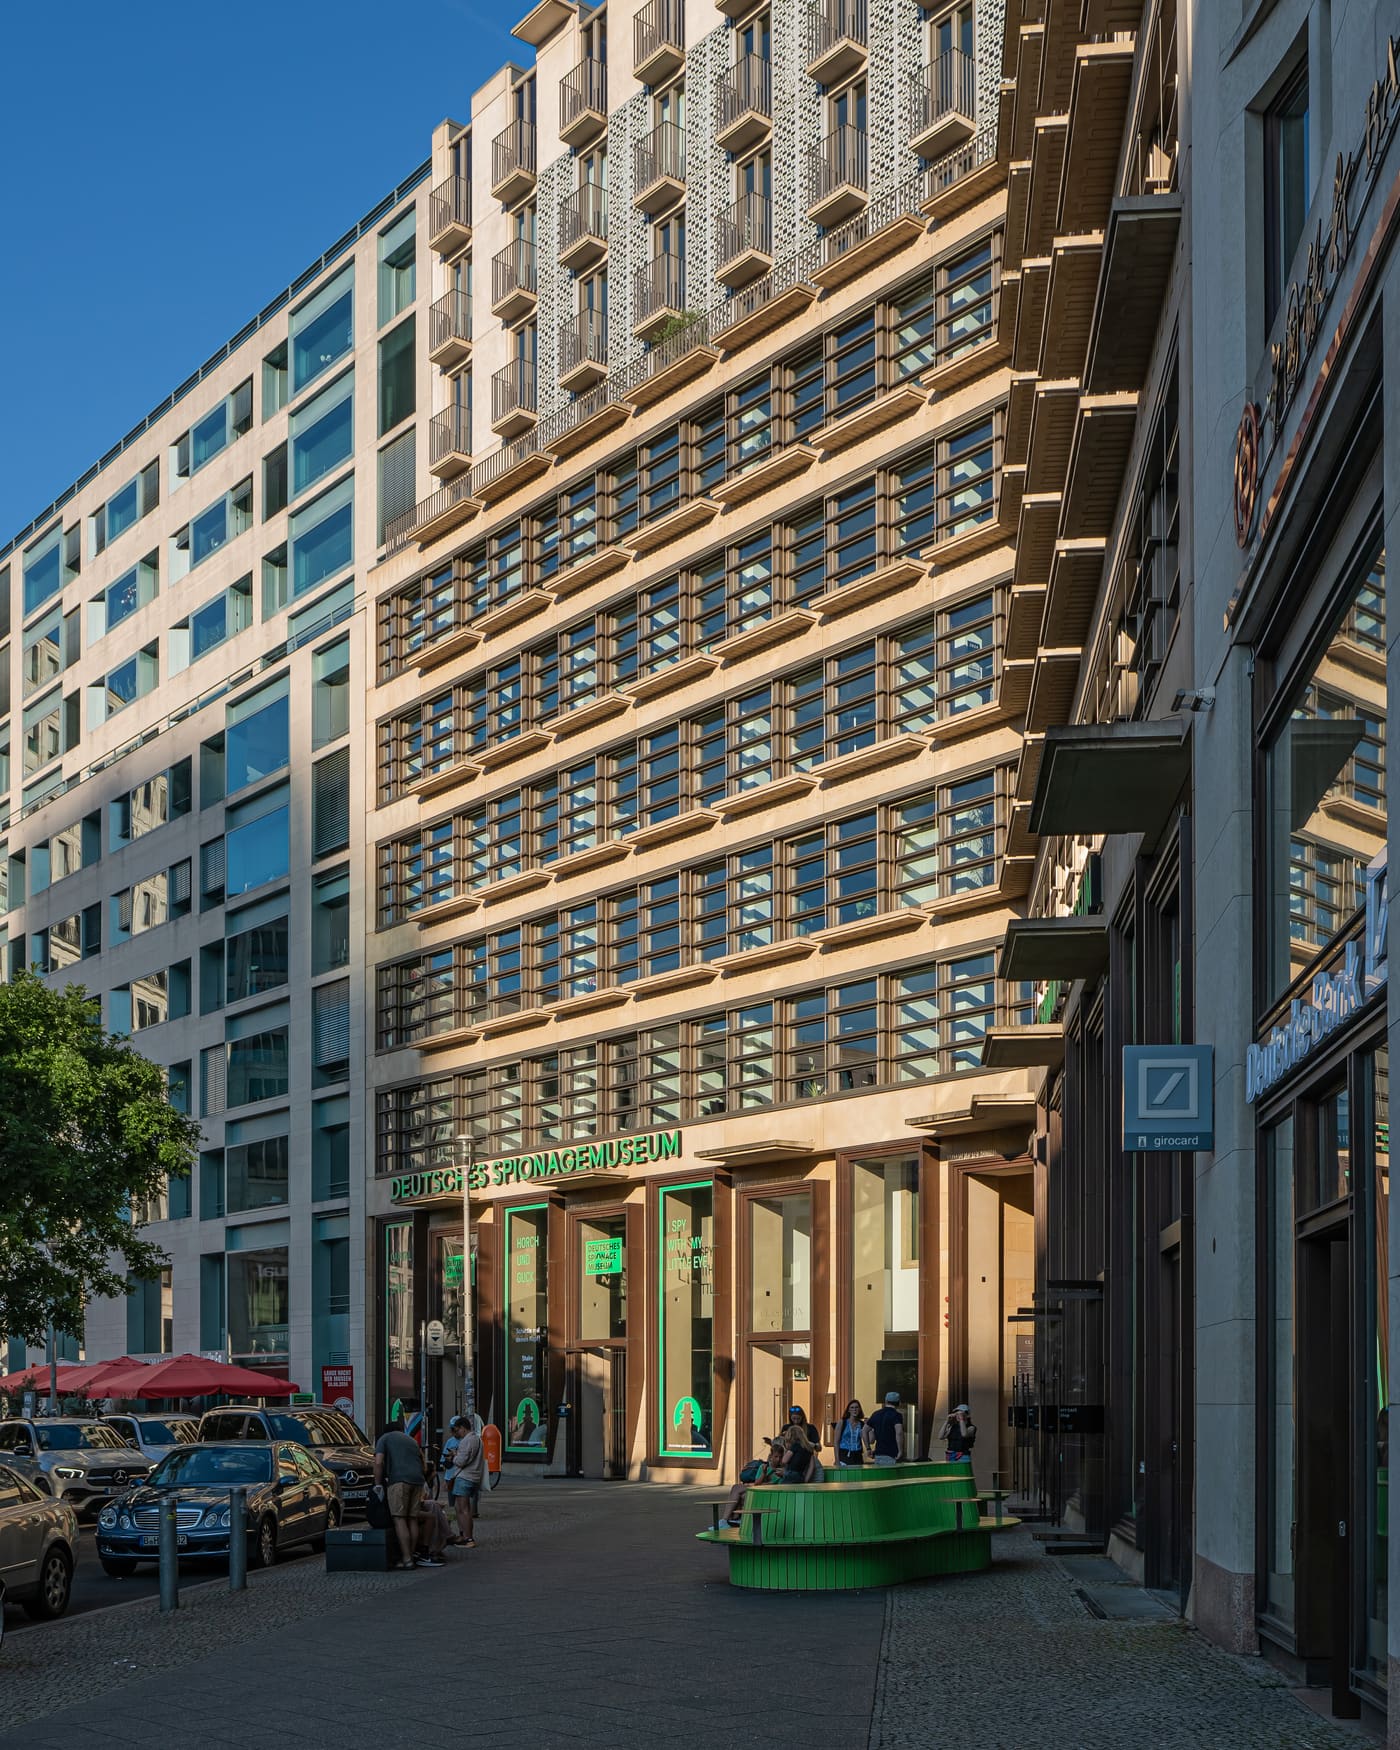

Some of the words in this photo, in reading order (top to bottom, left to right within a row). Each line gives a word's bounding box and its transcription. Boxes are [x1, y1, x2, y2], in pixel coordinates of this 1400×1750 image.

[1246, 999, 1313, 1104] Deutsche
[1312, 941, 1363, 1047] Bank
[1153, 1135, 1199, 1149] girocard
[391, 1164, 488, 1200] DEUTSCHES
[492, 1130, 682, 1185] SPIONAGEMUSEUM
[672, 1219, 687, 1232] SPY
[516, 1235, 540, 1249] HORCH
[588, 1242, 621, 1253] DEUTSCHES
[667, 1238, 687, 1252] WITH
[691, 1236, 703, 1249] MY
[694, 1255, 708, 1269] EYE
